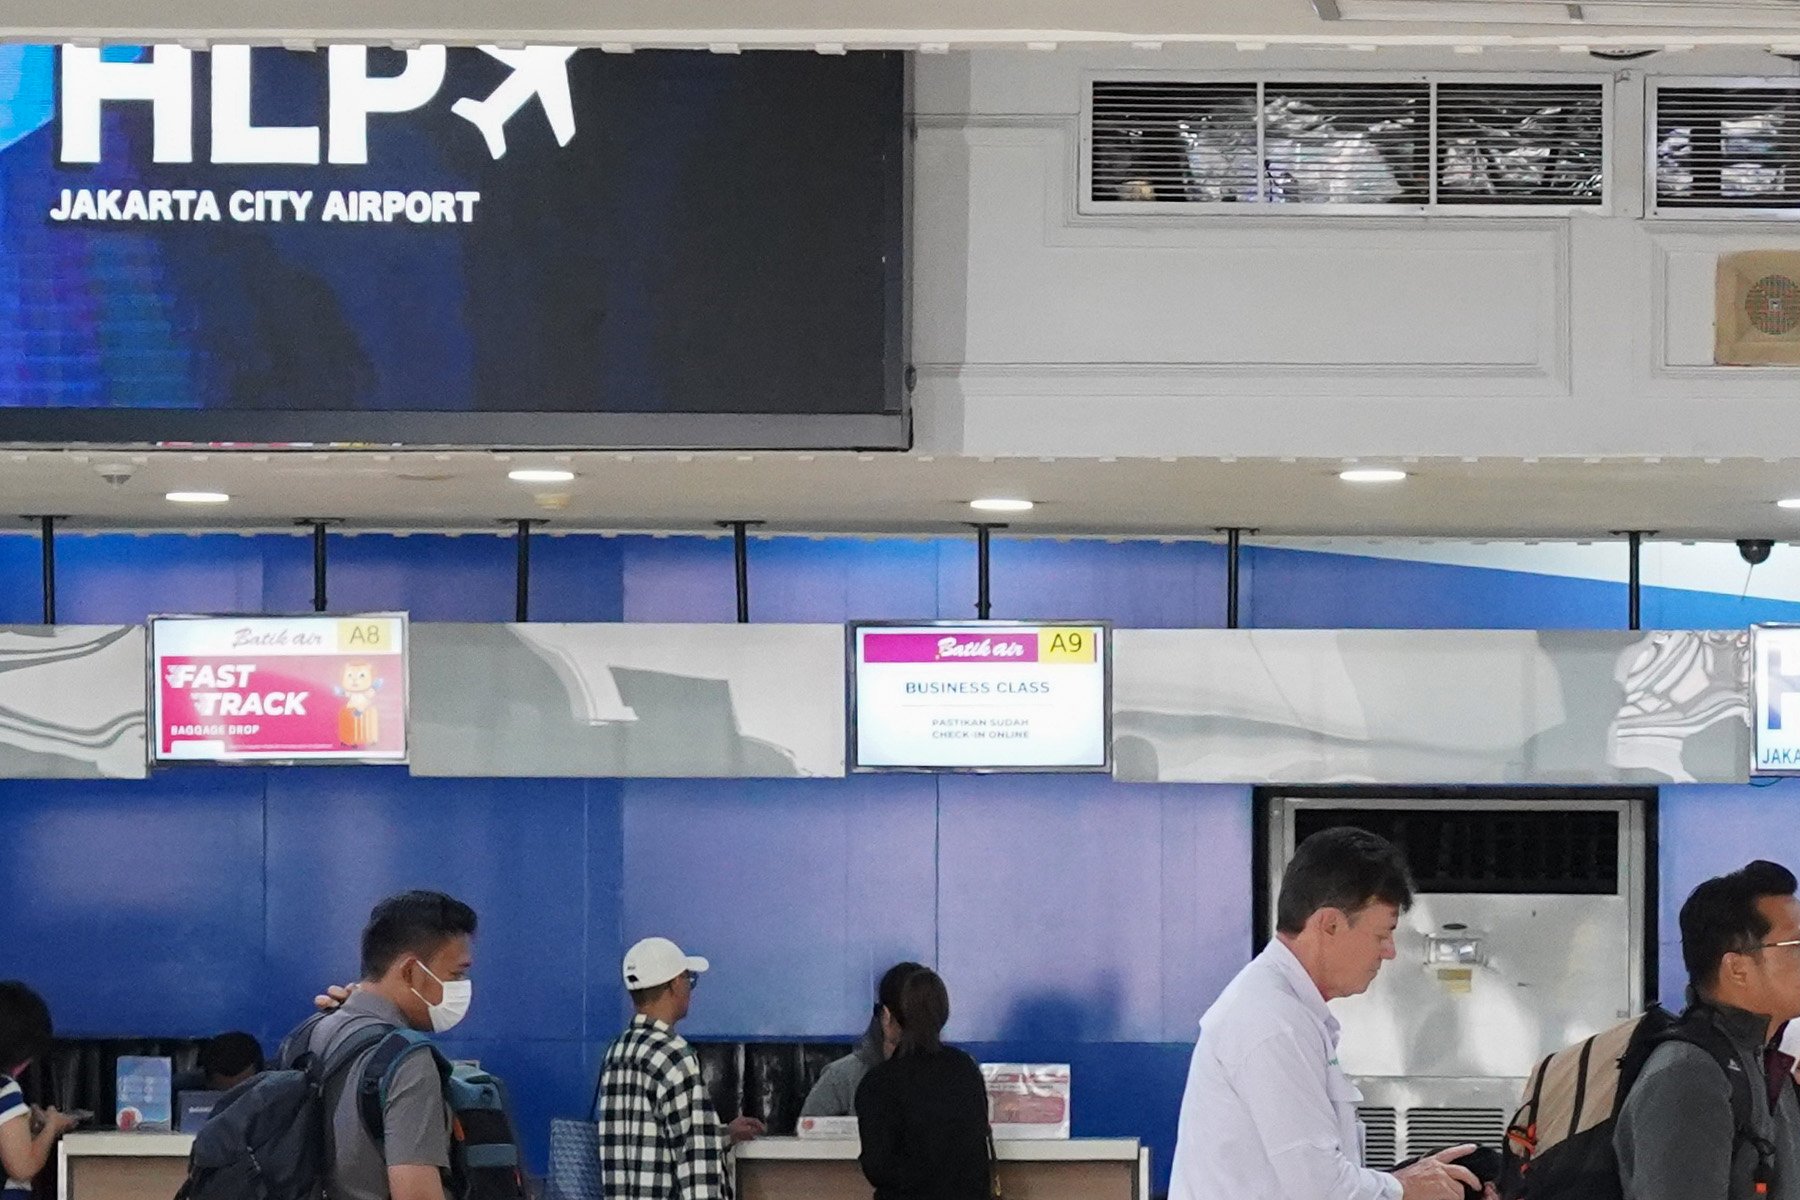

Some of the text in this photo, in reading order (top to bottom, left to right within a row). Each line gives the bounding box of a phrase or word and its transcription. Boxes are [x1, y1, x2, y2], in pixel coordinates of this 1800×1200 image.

[60, 44, 447, 164] HLP
[50, 189, 480, 223] JAKARTA CITY AIRPORT
[232, 627, 323, 648] Batik air
[349, 625, 380, 645] A8
[1050, 633, 1083, 653] A9
[936, 637, 1025, 658] Batik air
[165, 664, 257, 689] FAST
[906, 682, 1050, 694] BUSINESS CLASS
[191, 691, 310, 717] TRACK
[171, 724, 260, 736] BAGGAGE DROP
